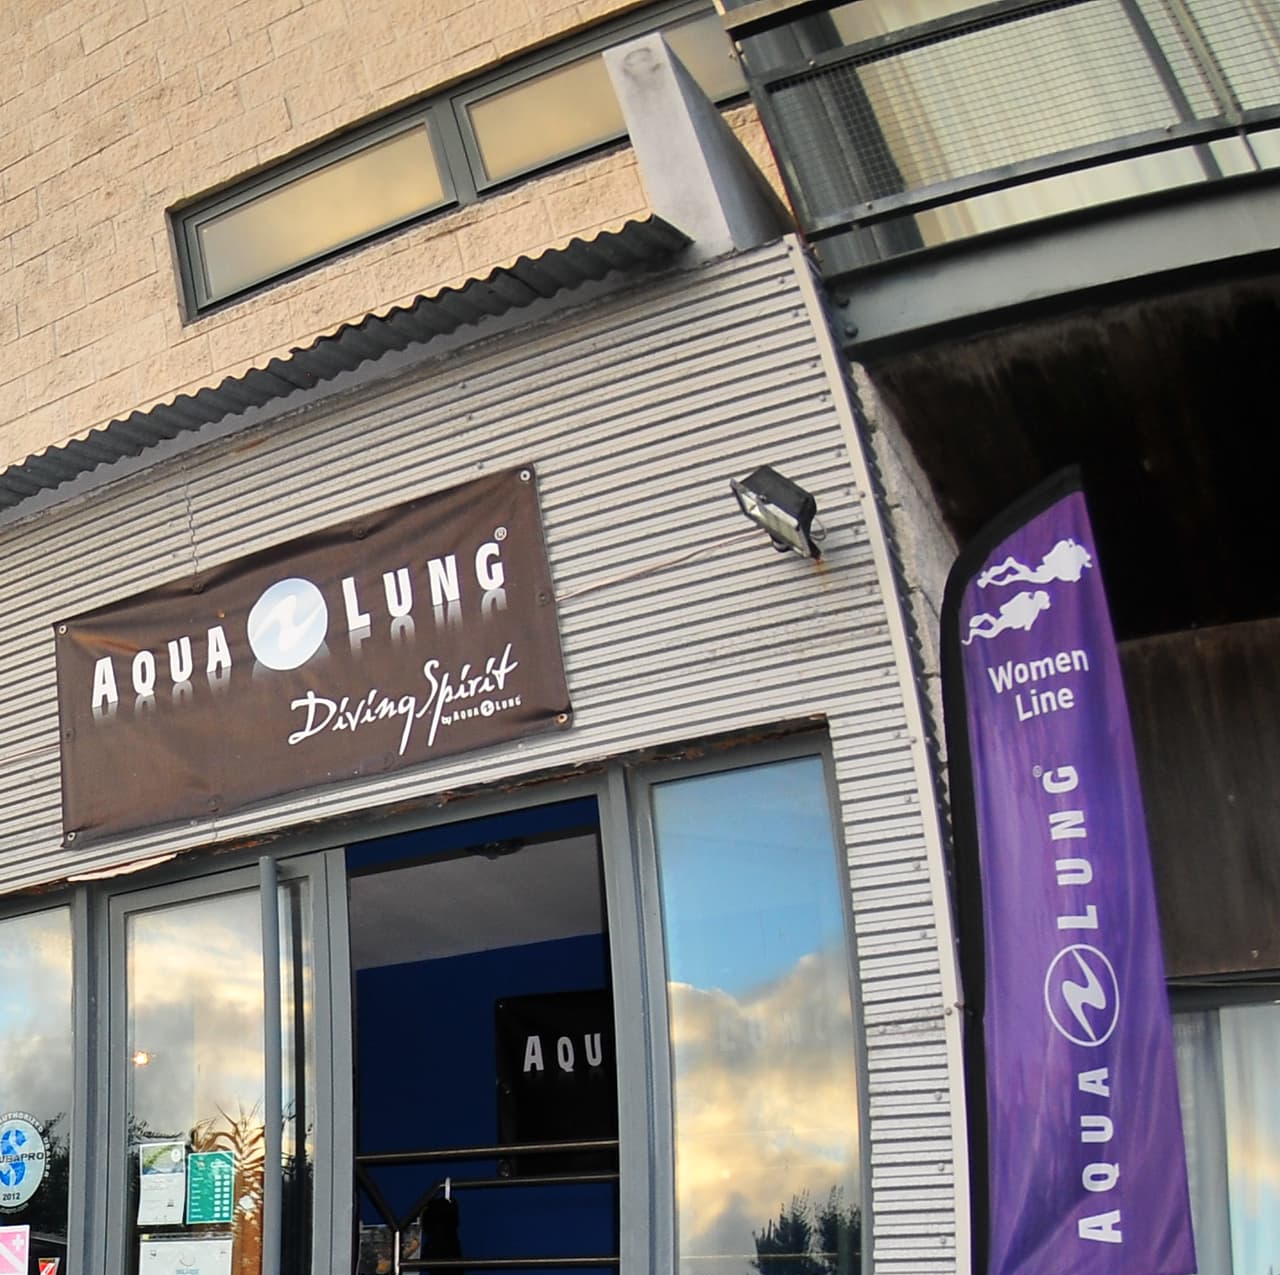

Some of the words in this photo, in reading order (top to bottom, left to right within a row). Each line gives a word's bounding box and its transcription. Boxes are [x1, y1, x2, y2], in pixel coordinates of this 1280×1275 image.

[91, 625, 233, 709] AQUA
[342, 542, 506, 632] LUNG
[987, 644, 1090, 695] Women
[288, 687, 417, 755] Diving
[416, 642, 519, 748] Spirit
[453, 706, 480, 721] AQUA
[1016, 685, 1076, 723] Line
[1042, 763, 1099, 932] LUNG
[523, 1032, 603, 1073] AQU
[1078, 1065, 1124, 1245] AQUA
[2, 1192, 21, 1201] 2012
